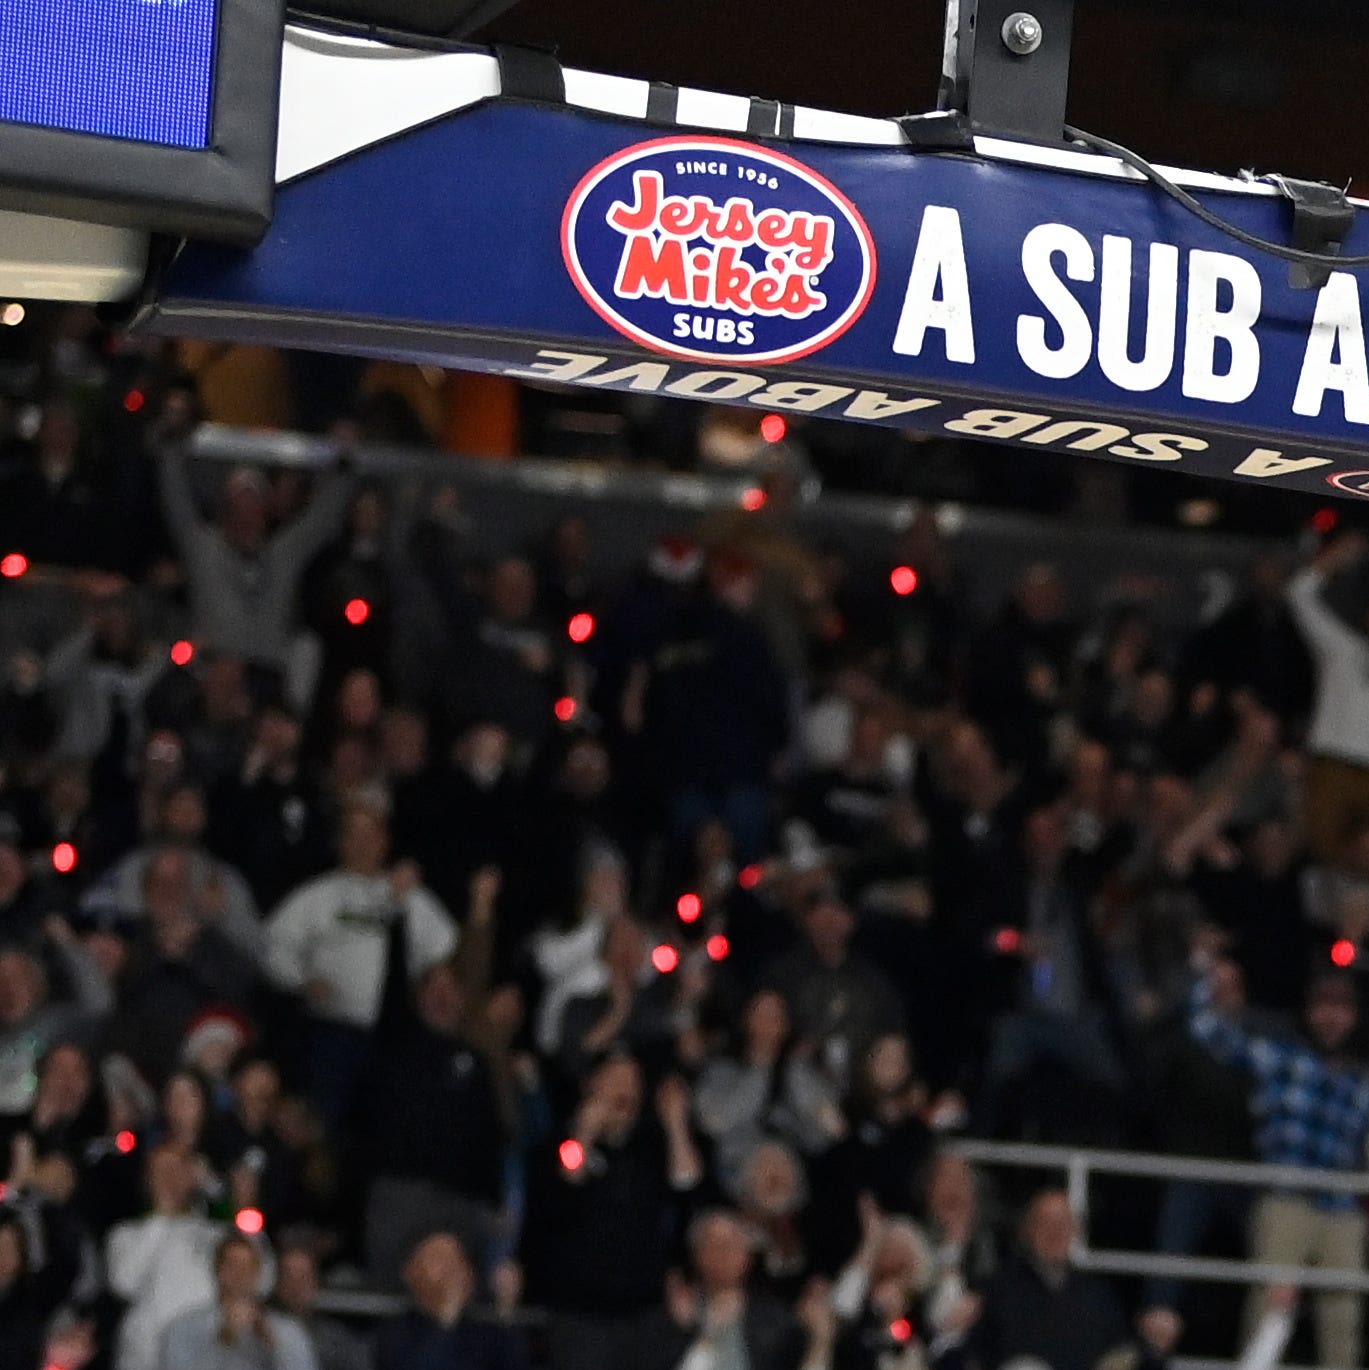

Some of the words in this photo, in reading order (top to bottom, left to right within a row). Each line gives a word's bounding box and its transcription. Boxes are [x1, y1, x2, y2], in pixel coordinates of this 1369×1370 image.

[675, 161, 728, 176] SINCE
[737, 166, 780, 190] 1956
[608, 172, 833, 271] Jersey
[615, 234, 825, 316] Mike's
[892, 204, 976, 365] A
[1015, 222, 1262, 404] SUB
[672, 312, 756, 346] SUBS
[503, 350, 943, 420] ABOVE
[943, 408, 1210, 462] SUB
[1231, 447, 1335, 478] A
